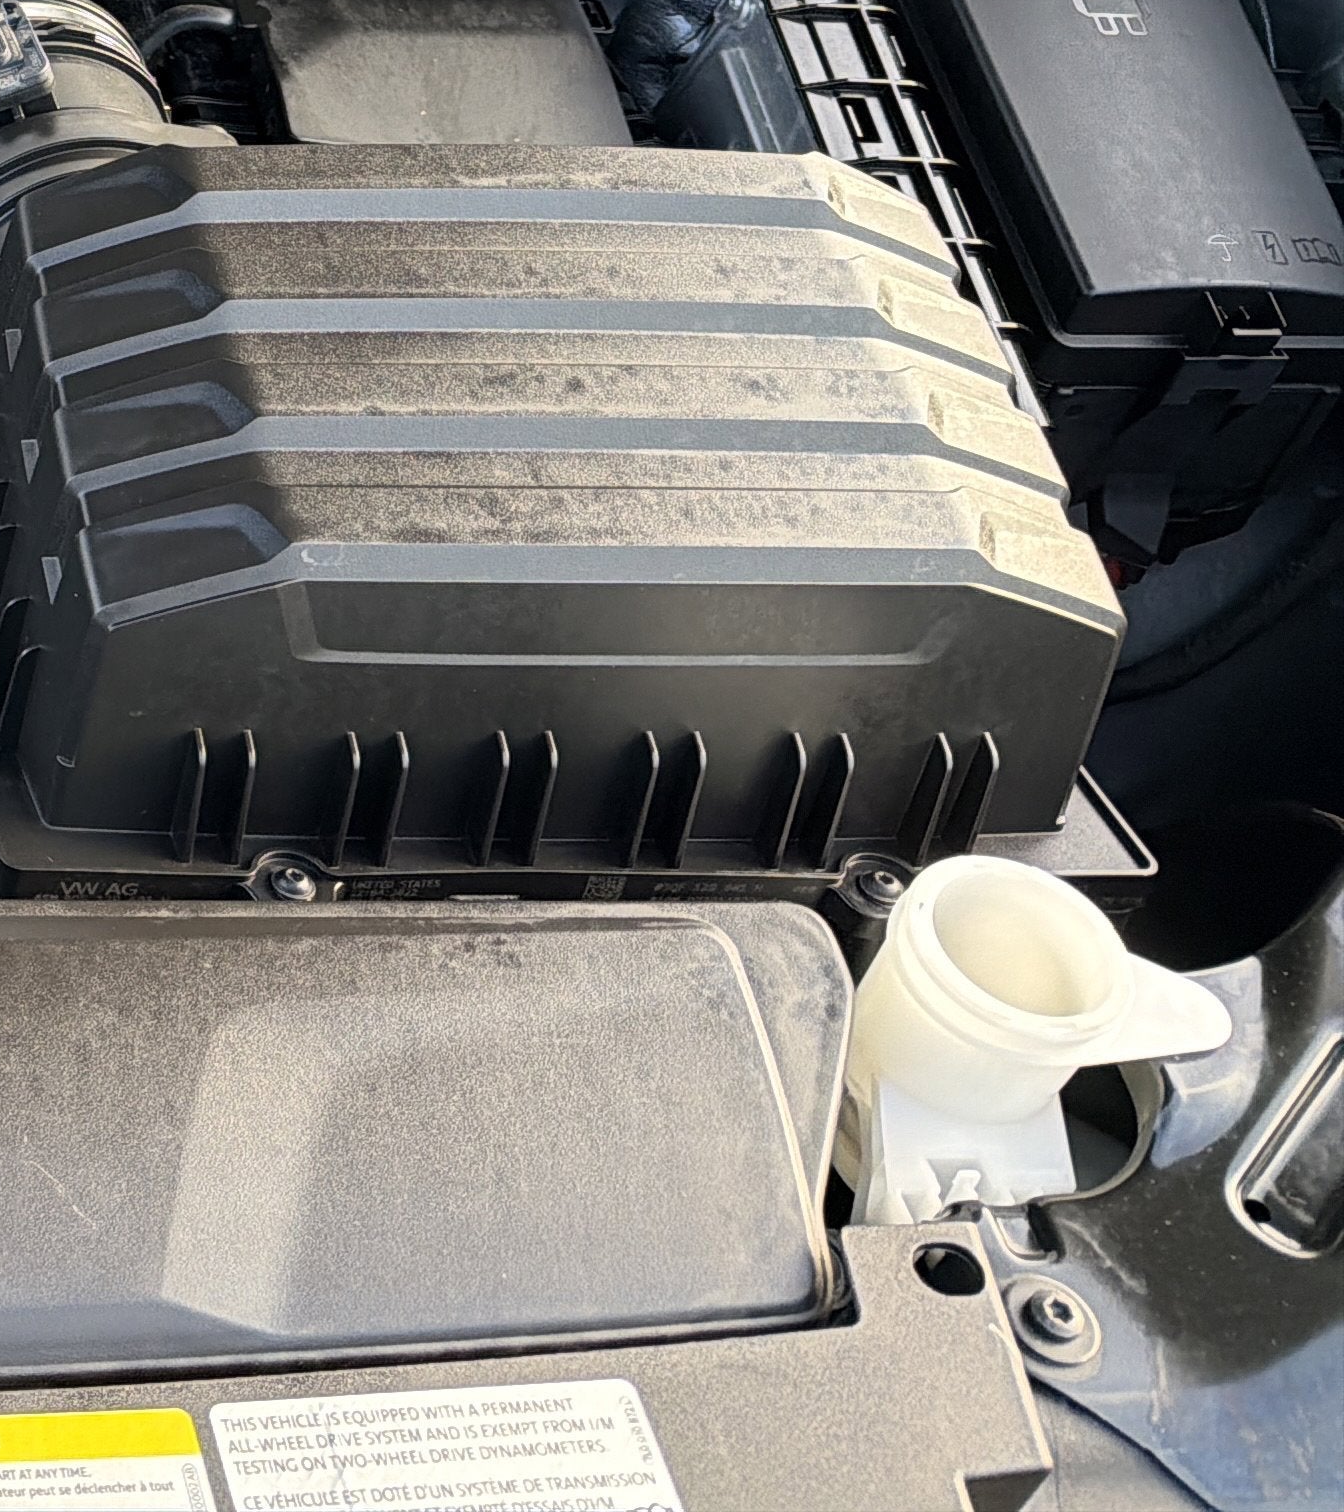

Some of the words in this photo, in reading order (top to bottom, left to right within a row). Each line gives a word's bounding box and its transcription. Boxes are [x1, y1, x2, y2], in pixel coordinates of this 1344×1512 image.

[60, 881, 99, 896] VW
[105, 882, 140, 896] AG
[220, 1417, 257, 1433] THIS
[259, 1413, 322, 1431] VEHICLE
[326, 1411, 341, 1427] IS
[343, 1406, 420, 1428] EQUIPPED
[422, 1404, 463, 1421] WITH
[468, 1403, 480, 1418] A
[482, 1397, 574, 1416] PERMANENT
[229, 1435, 314, 1454] ALL-WHEEL
[316, 1431, 362, 1449] DRIVE
[365, 1427, 423, 1446] SYSTEM
[426, 1425, 460, 1441] AND
[463, 1424, 478, 1439] IS
[481, 1420, 538, 1439] EXEMPT
[543, 1418, 585, 1434] FROM
[588, 1416, 615, 1432] I/M
[19, 1468, 32, 1480] AT
[35, 1467, 59, 1480] ANY
[233, 1458, 299, 1476] TESTING
[301, 1456, 327, 1472] ON
[329, 1449, 428, 1470] TWO-WHEEL
[429, 1446, 476, 1464] DRIVE
[29, 1484, 55, 1500] peut
[58, 1486, 72, 1496] se
[74, 1480, 137, 1495] déclencher
[150, 1479, 174, 1492] tout
[243, 1496, 263, 1511] CE
[264, 1490, 339, 1510] VÉHICULE
[342, 1488, 367, 1505] EST
[371, 1483, 411, 1503] DOTÉ
[414, 1483, 454, 1500] D'UN
[456, 1478, 521, 1498] SYSTÈME
[523, 1478, 544, 1493] DE
[546, 1472, 656, 1491] TRANSMISSION
